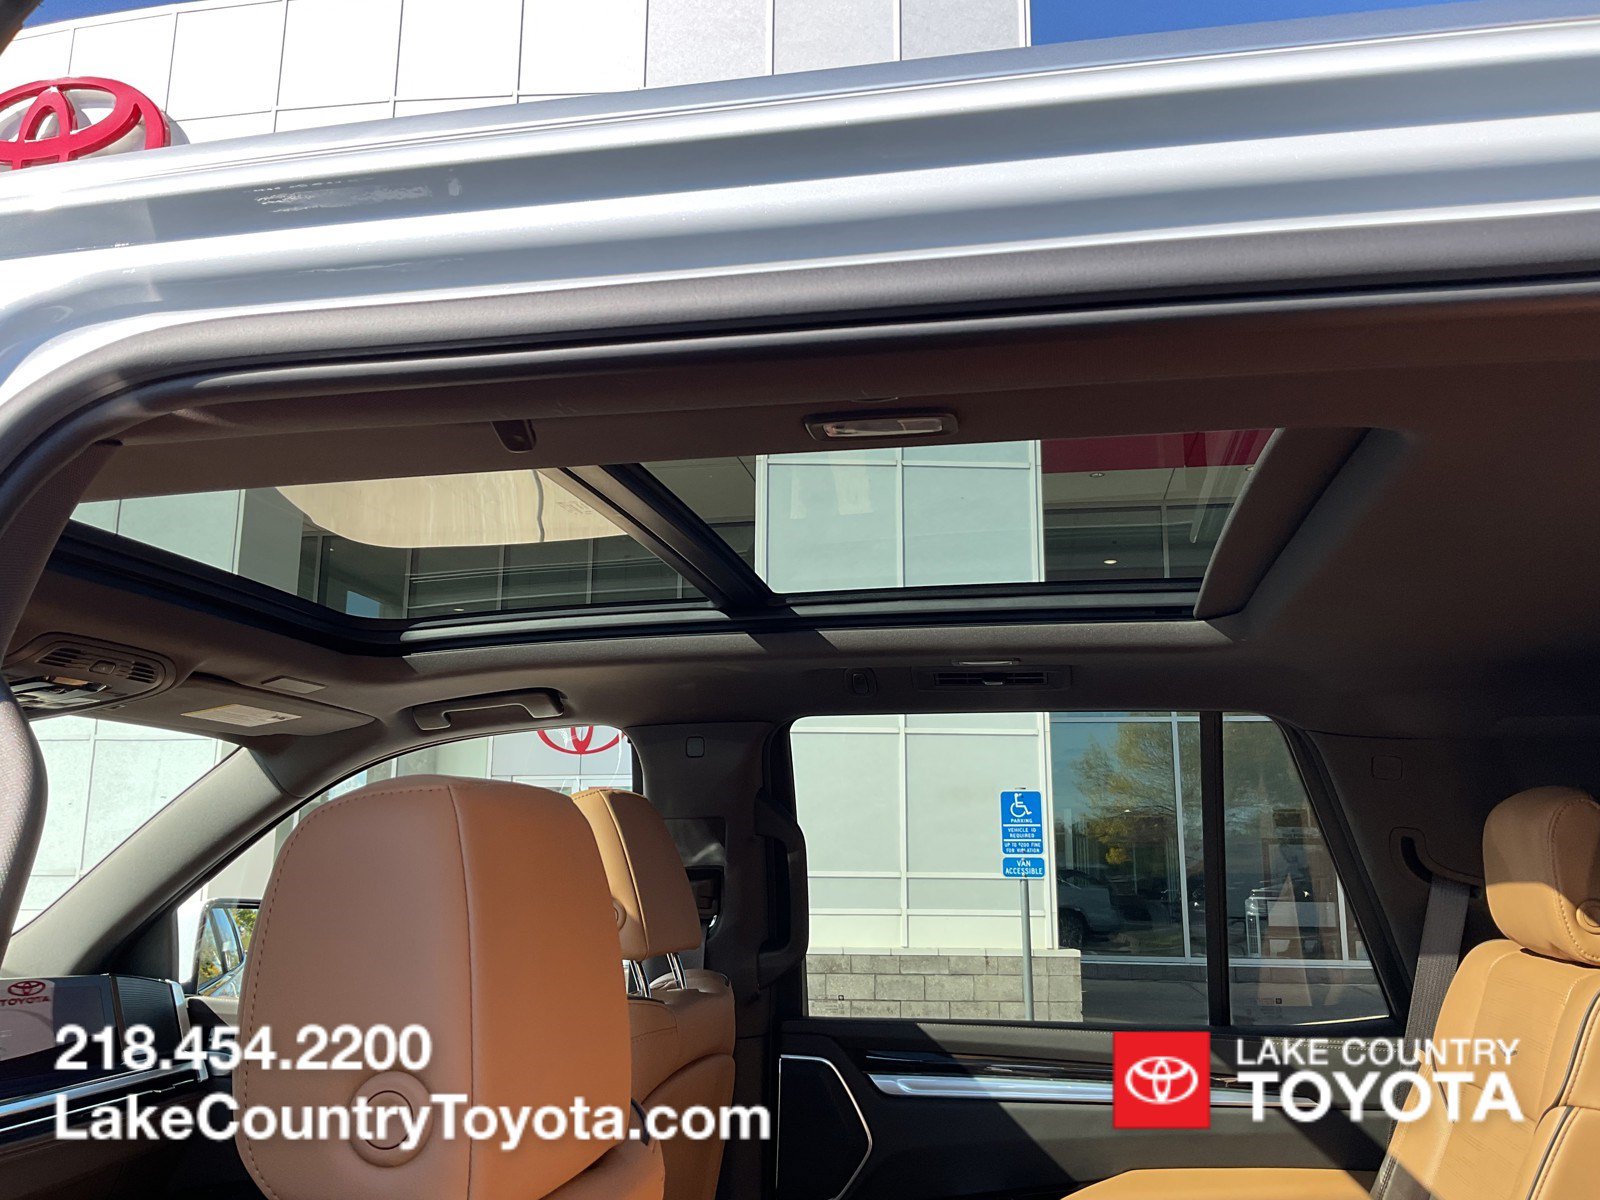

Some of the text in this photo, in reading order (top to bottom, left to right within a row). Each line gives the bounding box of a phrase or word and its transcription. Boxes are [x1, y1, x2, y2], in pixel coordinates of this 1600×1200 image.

[1016, 859, 1031, 867] VAN
[1005, 867, 1043, 875] ACCESSIBLE
[0, 996, 49, 1006] TOYOTA
